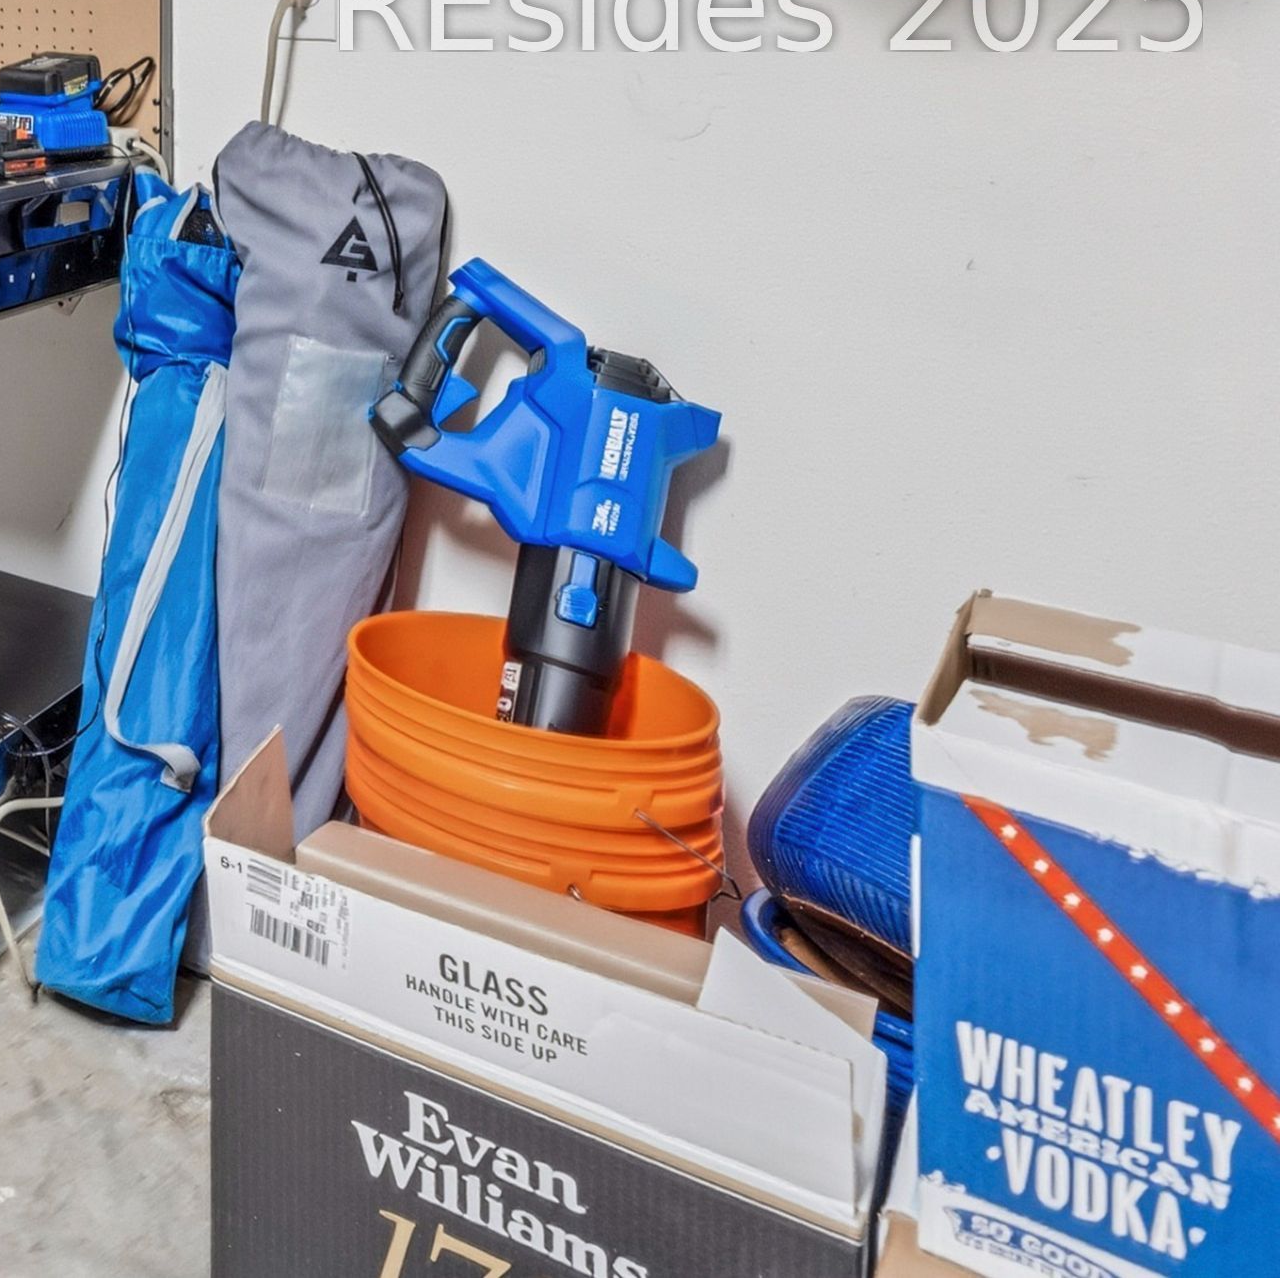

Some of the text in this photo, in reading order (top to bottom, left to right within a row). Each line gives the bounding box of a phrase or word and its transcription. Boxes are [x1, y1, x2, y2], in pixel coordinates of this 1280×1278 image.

[405, 974, 589, 1057] HANDLE WITH CARE
[432, 1004, 558, 1064] THIS SIDE UP
[439, 953, 549, 1016] GLASS
[401, 1089, 588, 1215] Evan
[955, 1020, 1243, 1181] WHEATLEY
[963, 1088, 1232, 1211] AMERICAN
[970, 1214, 1013, 1245] SO
[1001, 1127, 1188, 1261] VODKA
